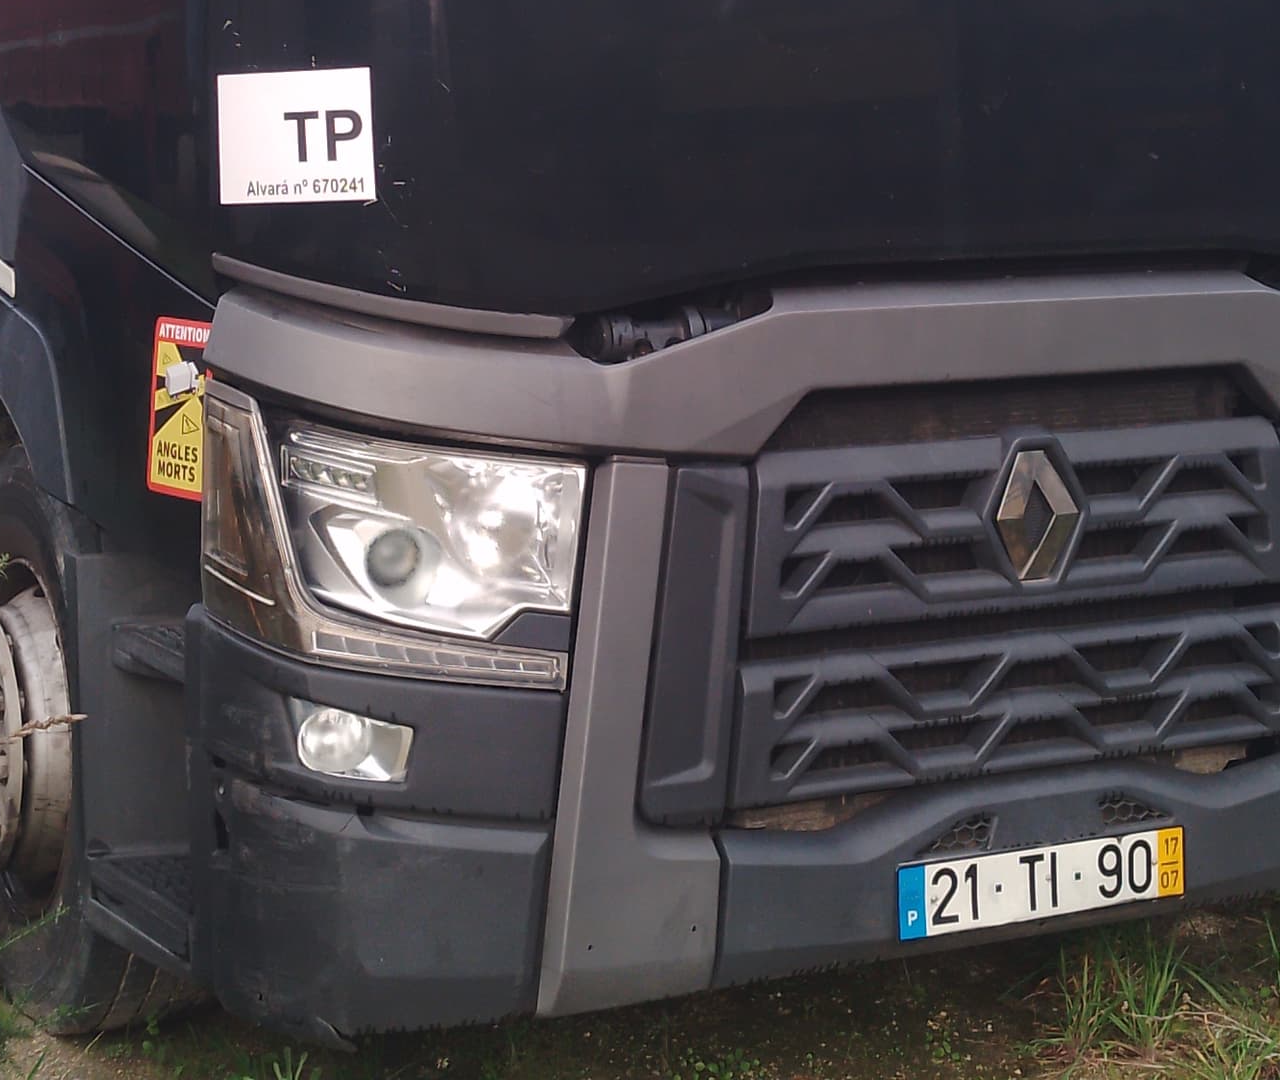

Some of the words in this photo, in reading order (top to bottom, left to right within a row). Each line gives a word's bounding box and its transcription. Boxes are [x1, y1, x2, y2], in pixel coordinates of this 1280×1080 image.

[283, 109, 363, 163] TP
[246, 179, 289, 197] Alvará
[293, 179, 308, 195] nº
[312, 177, 365, 194] 670241
[159, 322, 211, 344] ATTENTION
[156, 439, 198, 464] ANGLES
[157, 461, 196, 483] MORTS
[1163, 836, 1179, 856] 17
[1160, 869, 1179, 889] 07
[907, 910, 919, 926] P
